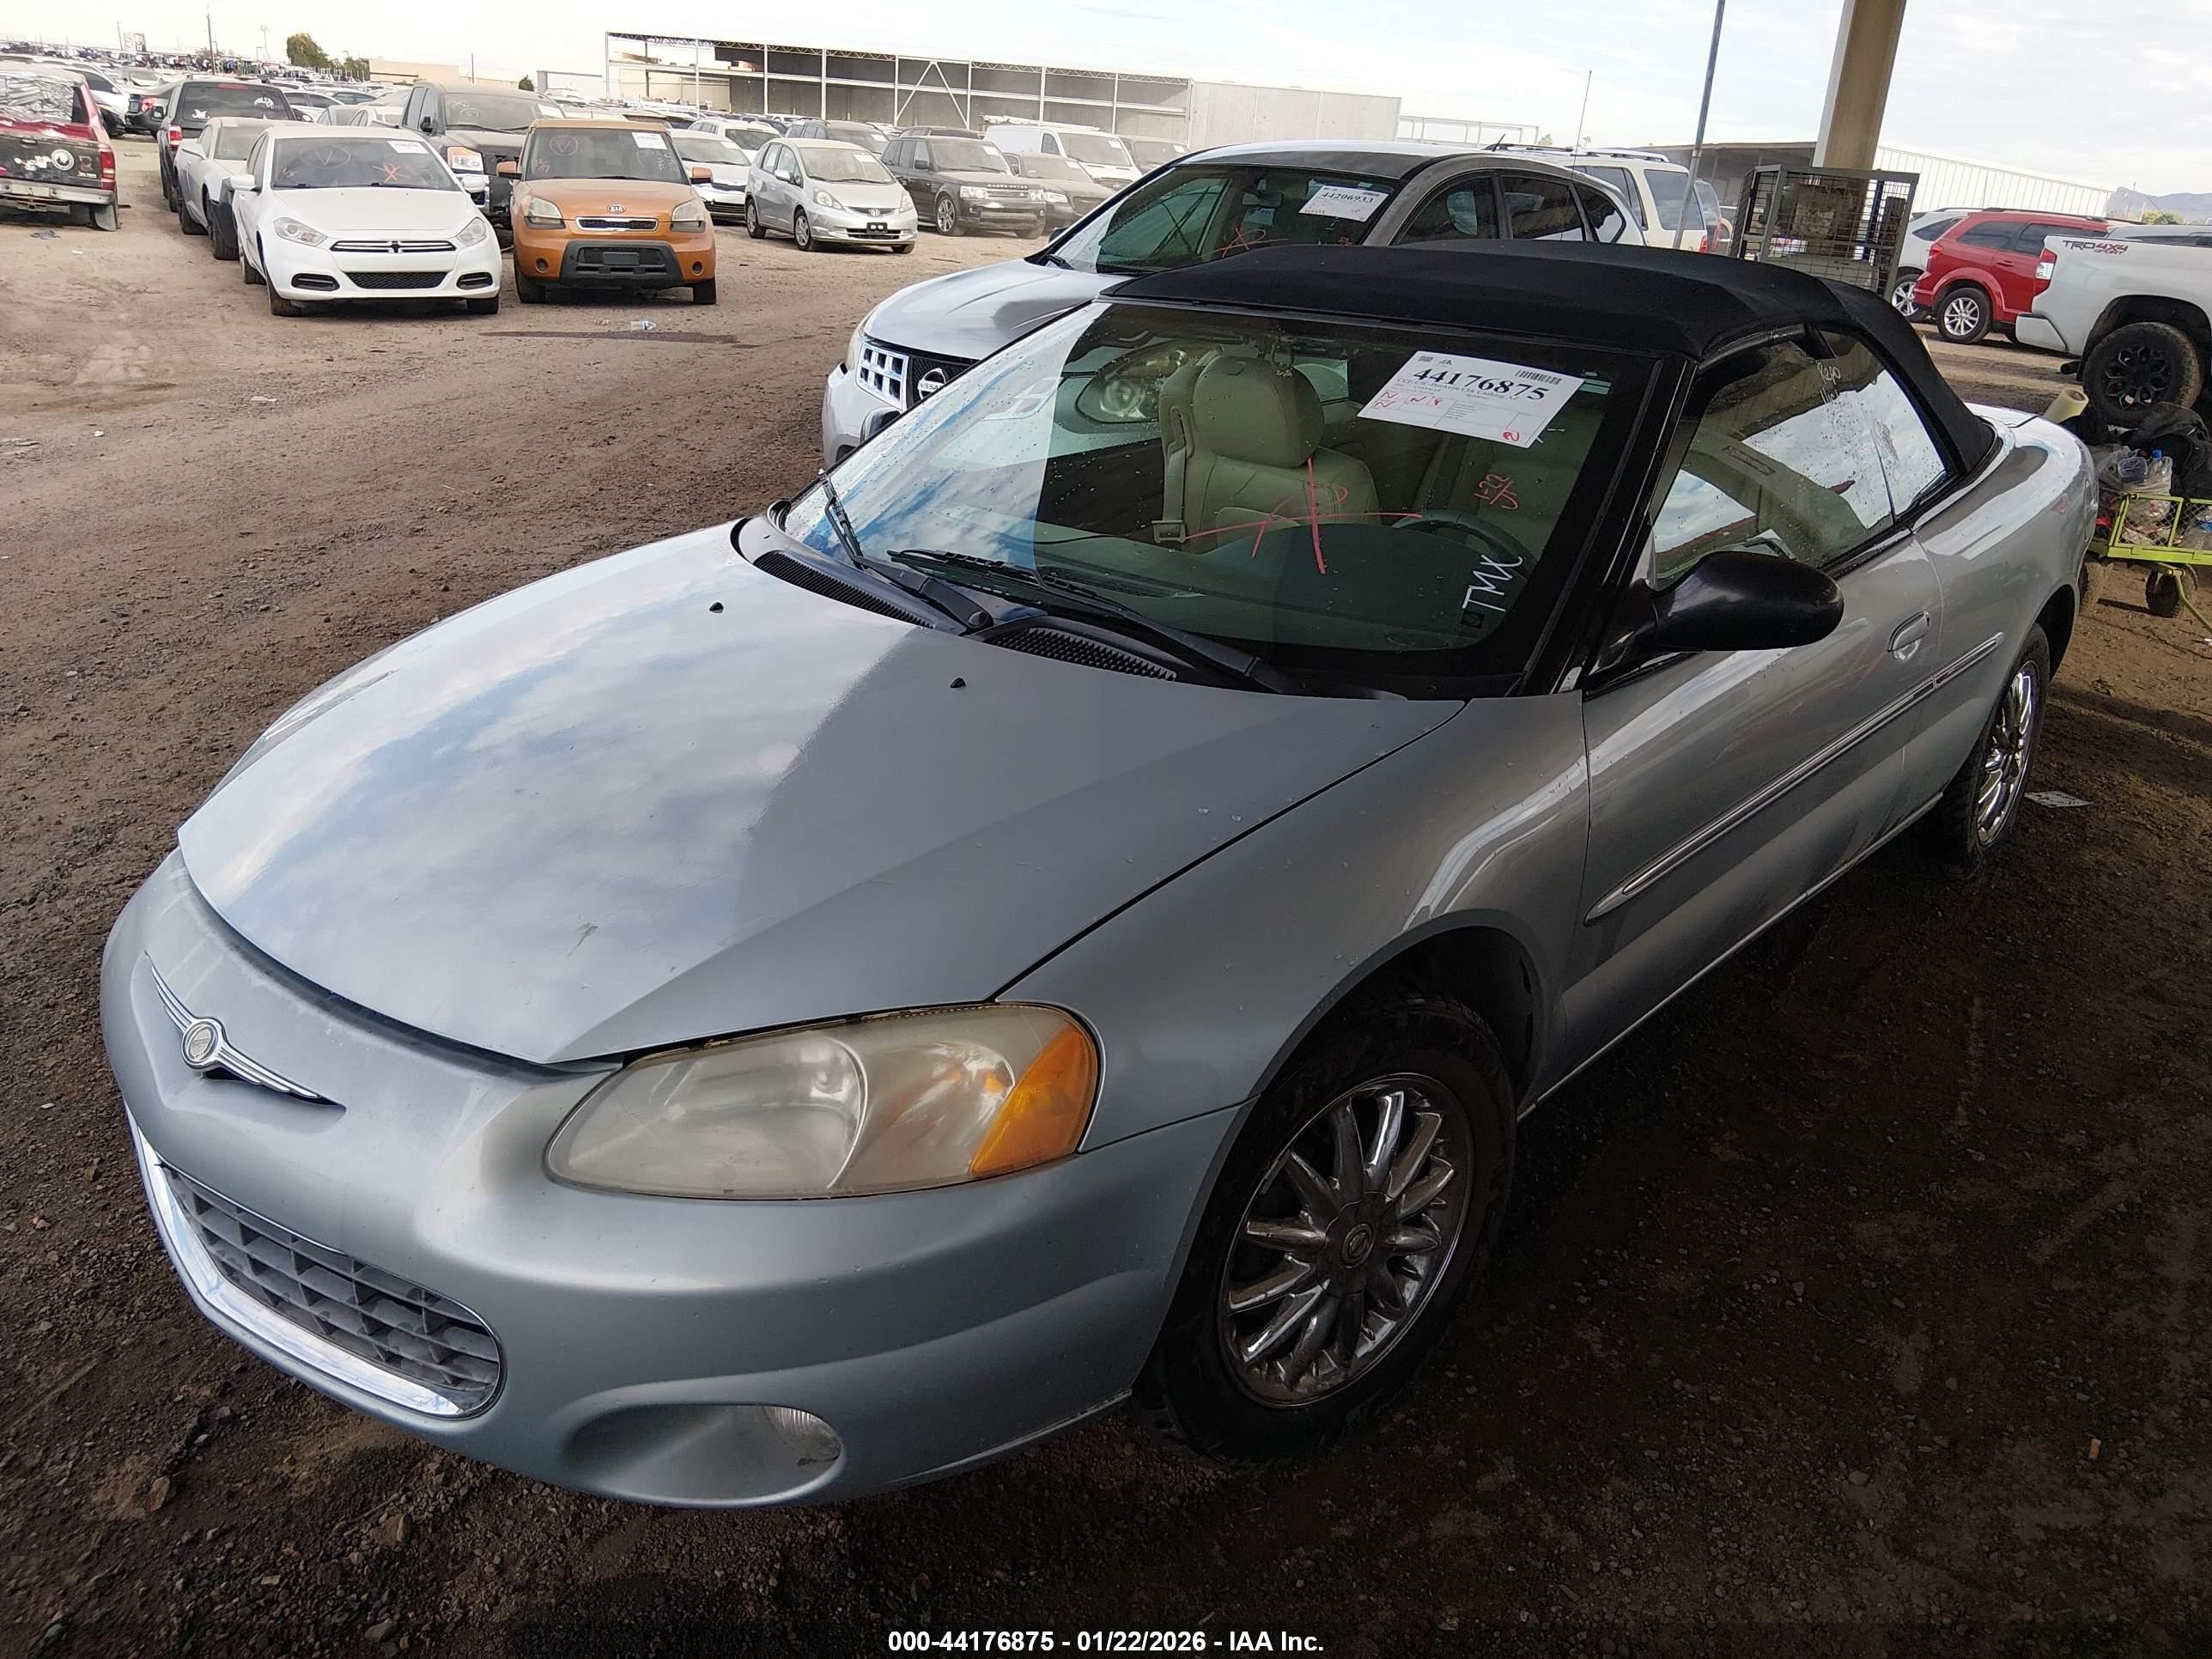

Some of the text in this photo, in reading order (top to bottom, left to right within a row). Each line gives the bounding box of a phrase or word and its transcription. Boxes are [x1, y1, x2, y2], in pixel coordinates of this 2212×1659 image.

[1322, 191, 1374, 204] 44206933
[2063, 240, 2095, 251] TRD
[1413, 368, 1550, 400] 44176875
[1462, 554, 1523, 612] TMX
